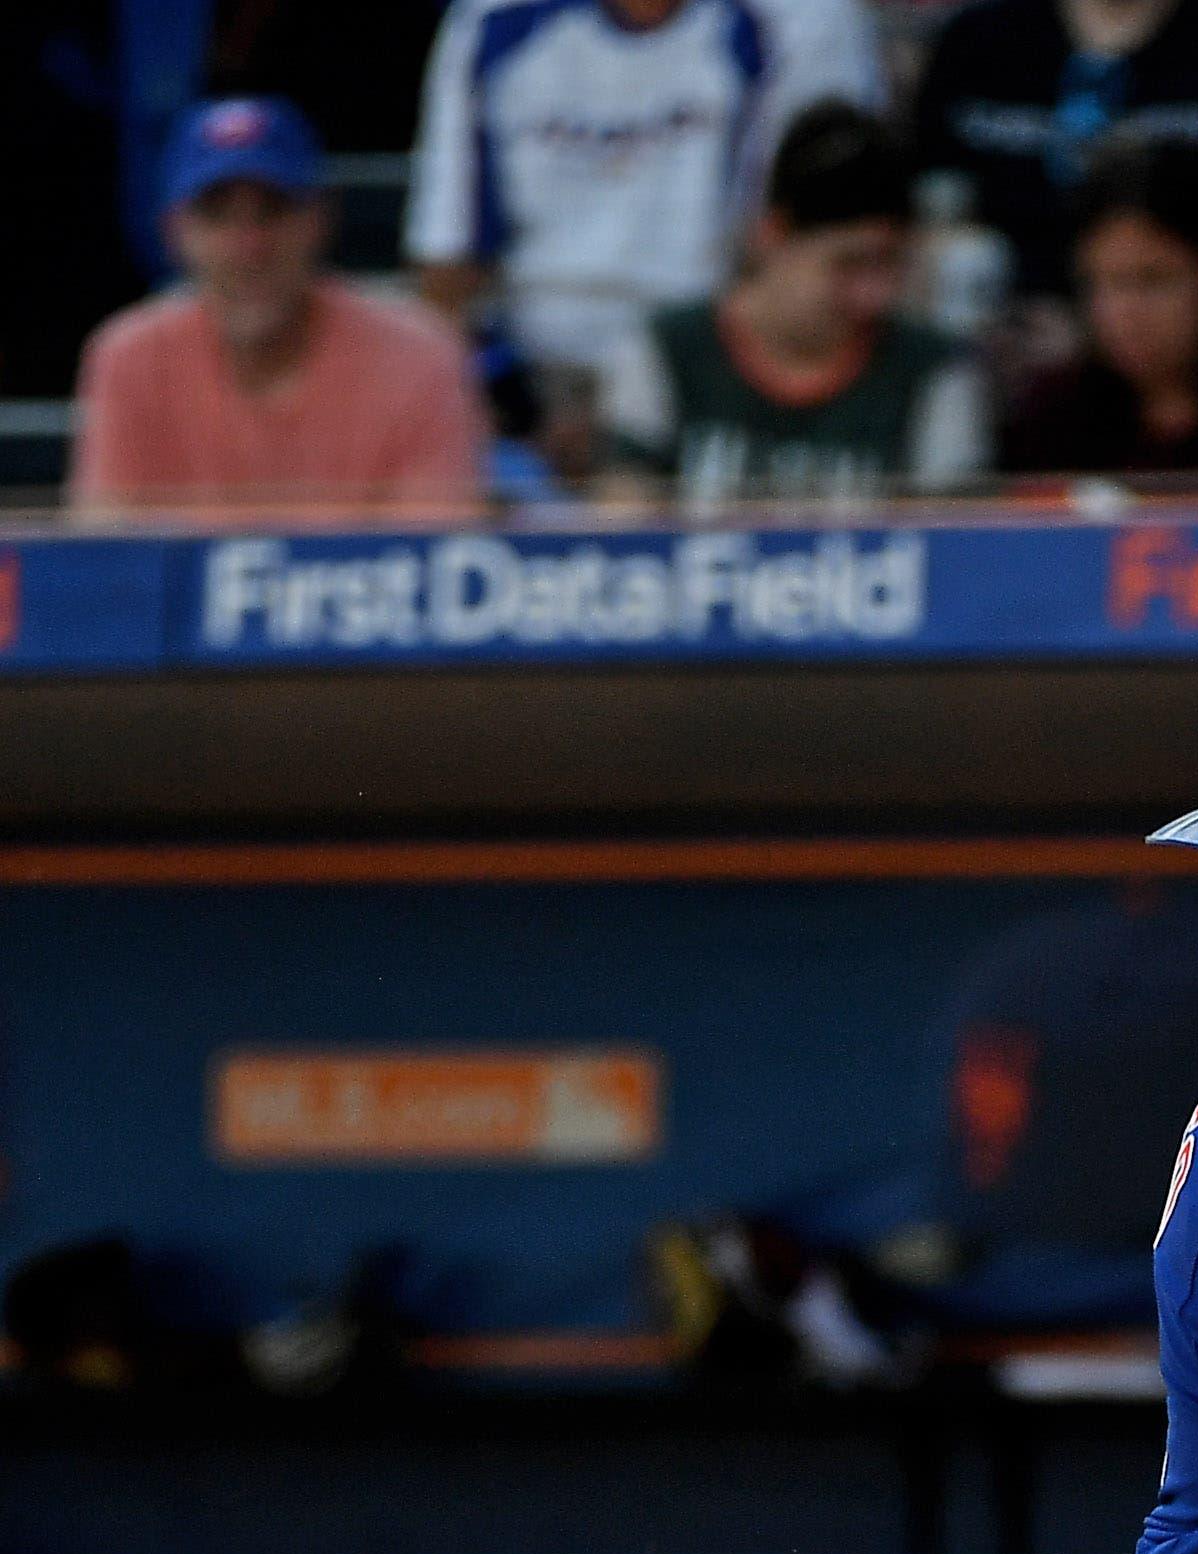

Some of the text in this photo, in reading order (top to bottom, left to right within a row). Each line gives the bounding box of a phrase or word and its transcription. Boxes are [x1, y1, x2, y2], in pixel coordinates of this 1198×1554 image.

[202, 528, 928, 652] First Data Field
